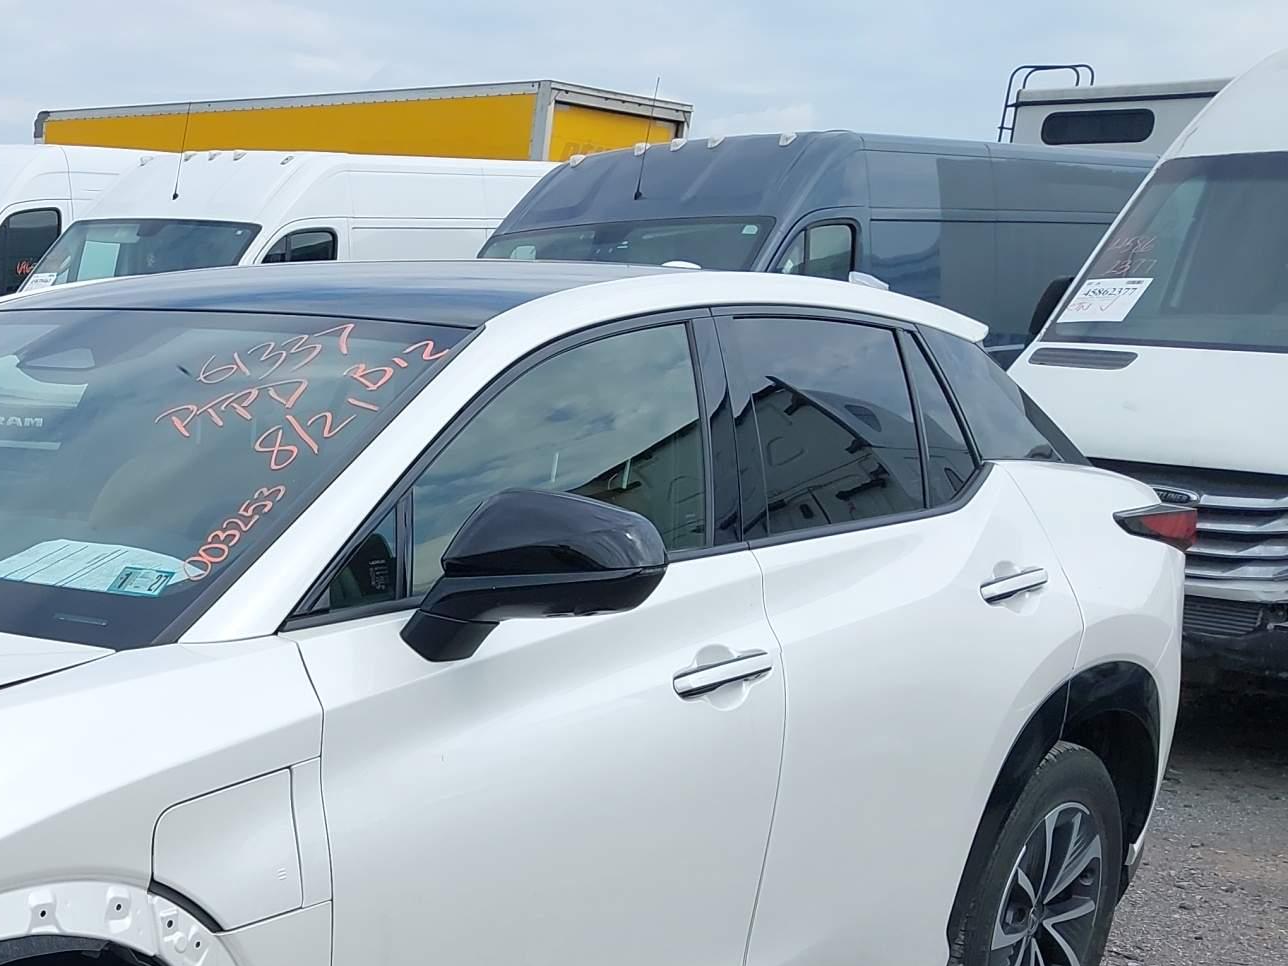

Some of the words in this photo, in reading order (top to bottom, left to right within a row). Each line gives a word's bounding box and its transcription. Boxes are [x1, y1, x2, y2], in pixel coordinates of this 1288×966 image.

[1082, 287, 1138, 297] 45862377
[196, 323, 355, 384] 61337
[254, 398, 379, 470] 8/21
[183, 485, 286, 581] 003253
[147, 574, 169, 592] 27
